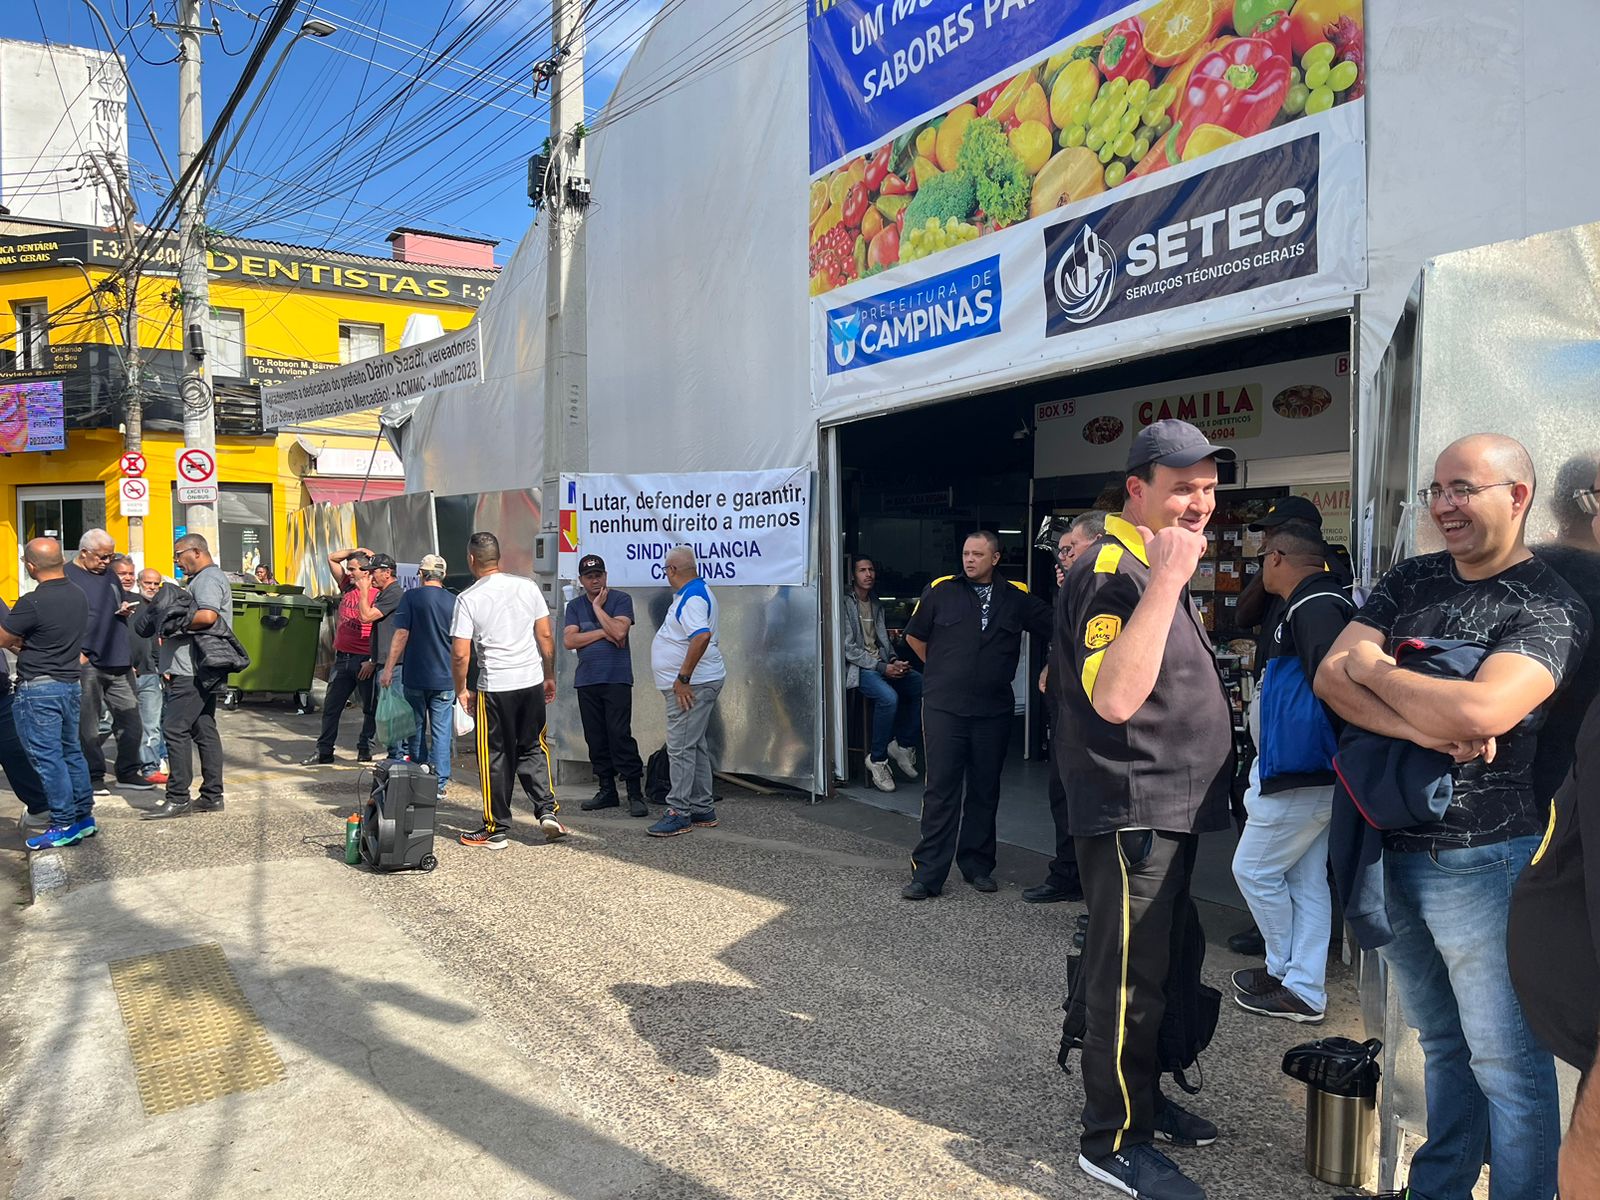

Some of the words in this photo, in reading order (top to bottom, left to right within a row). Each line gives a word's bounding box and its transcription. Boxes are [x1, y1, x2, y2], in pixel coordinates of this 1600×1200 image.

[851, 3, 885, 55] UM
[863, 9, 975, 103] SABORES
[1126, 187, 1306, 277] SETEC
[20, 253, 51, 262] GERAIS
[206, 250, 450, 298] DENTISTAS
[1126, 275, 1190, 301] SERVIÇOS
[1184, 257, 1251, 285] TÉCNICOS
[1253, 242, 1306, 268] GERAIS
[861, 283, 958, 322] PREFEITURA
[971, 269, 992, 289] DE
[860, 289, 993, 355] CAMPINAS
[252, 358, 265, 366] Dr.
[267, 359, 299, 368] Robson
[300, 361, 311, 369] M.
[258, 366, 274, 374] Dra
[302, 379, 332, 397] dedicação
[332, 376, 341, 391] do
[341, 370, 367, 392] prefeito
[366, 359, 394, 381] Dário
[428, 338, 477, 363] vereadores
[307, 398, 345, 417] revitalização
[344, 395, 354, 410] do
[352, 385, 391, 407] Mercadão!
[432, 361, 477, 389] Julho/2023
[1039, 403, 1060, 419] BOX
[1063, 400, 1074, 415] 95
[1138, 386, 1255, 426] CAMILA
[355, 457, 394, 472] BAR
[582, 492, 631, 514] Lutar,
[636, 490, 712, 509] defender
[715, 492, 727, 508] e
[732, 483, 806, 512] garantir,
[589, 514, 658, 534] nenhum
[661, 512, 718, 533] direito
[722, 515, 732, 531] a
[738, 510, 801, 530] menos
